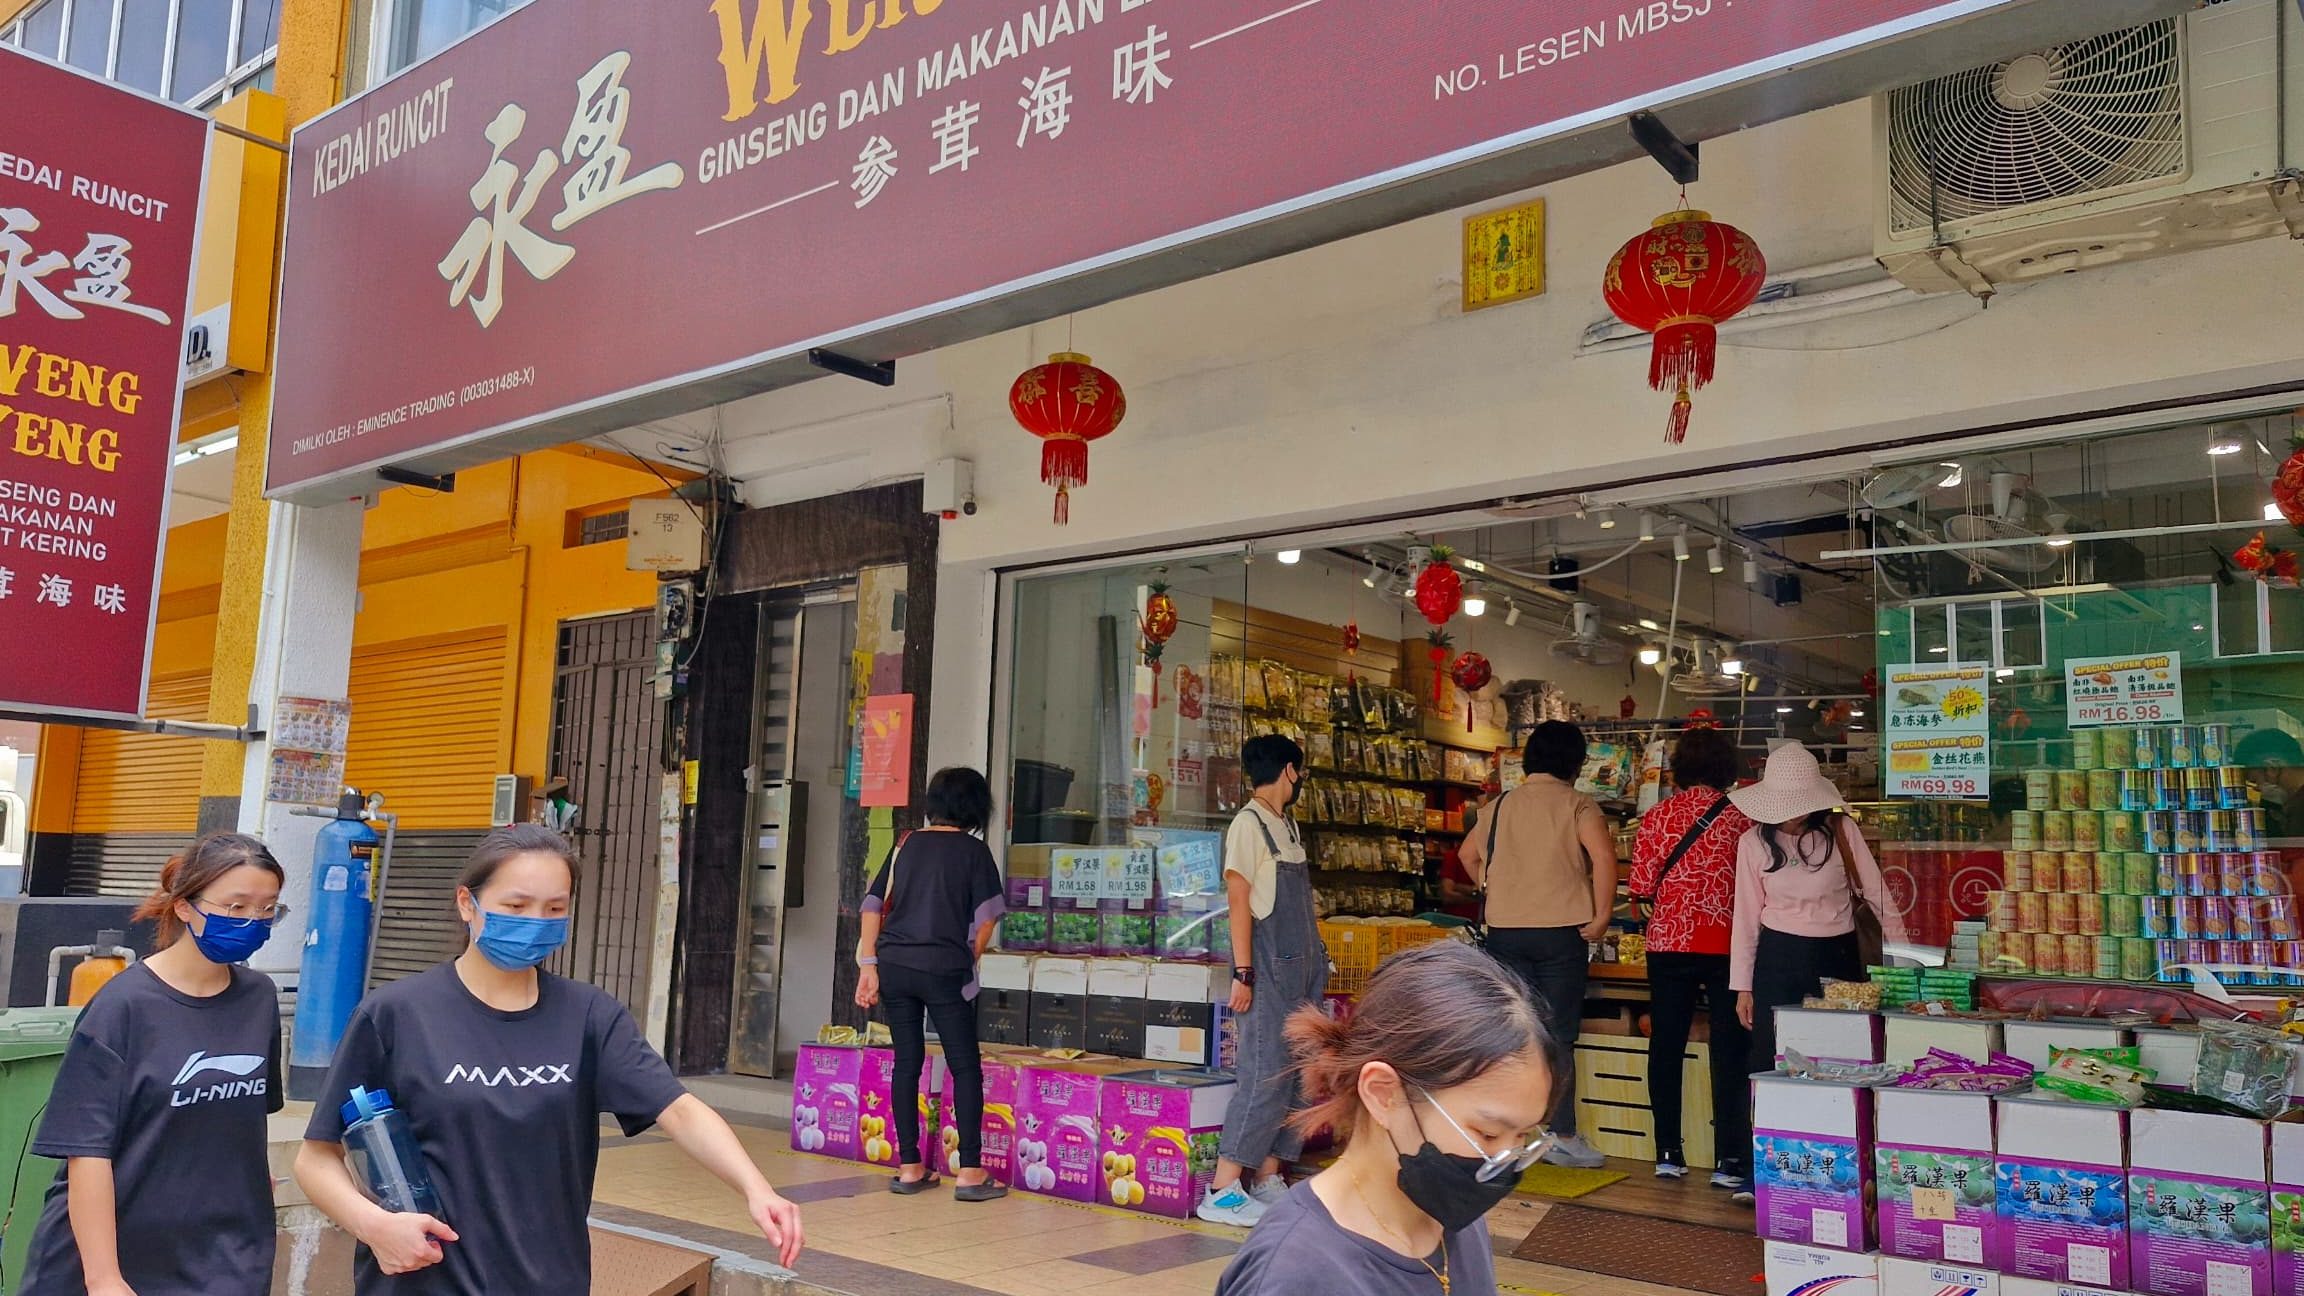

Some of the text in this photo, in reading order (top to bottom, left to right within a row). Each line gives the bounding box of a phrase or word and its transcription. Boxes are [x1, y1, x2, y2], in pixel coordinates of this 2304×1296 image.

[1435, 64, 1486, 100] NO.
[1499, 21, 1605, 79] LESEN
[698, 102, 827, 184] GINSENG
[838, 67, 905, 130] DAN
[917, 0, 1104, 98] MAKANAN
[850, 24, 1174, 209] 参茸海味
[313, 76, 454, 198] KEDAI RUNCIT
[71, 175, 168, 222] RUNCIT
[436, 50, 686, 329] 永盈
[292, 431, 325, 455] DIMILKI
[325, 425, 350, 445] OLEH
[357, 406, 407, 436] EMINENCE
[410, 391, 455, 419] TRADING
[68, 492, 116, 517] DAN
[20, 531, 107, 561] KERING
[2074, 664, 2111, 675] SPECIAL
[2112, 660, 2143, 671] OFFER
[2079, 705, 2161, 721] RM 16.98
[1893, 740, 1928, 750] SPECIAL
[1929, 738, 1957, 747] OFFER
[1901, 780, 1975, 793] RM 69.98
[1059, 880, 1096, 891] RM 1.68
[1108, 880, 1146, 891] RM 1.98
[169, 1077, 267, 1108] LI-NING
[1776, 1151, 1835, 1176] 羅漢果
[1901, 1164, 1968, 1189] 羅漢果
[2023, 1180, 2096, 1207] 羅漢果
[2158, 1194, 2238, 1224] 羅漢果
